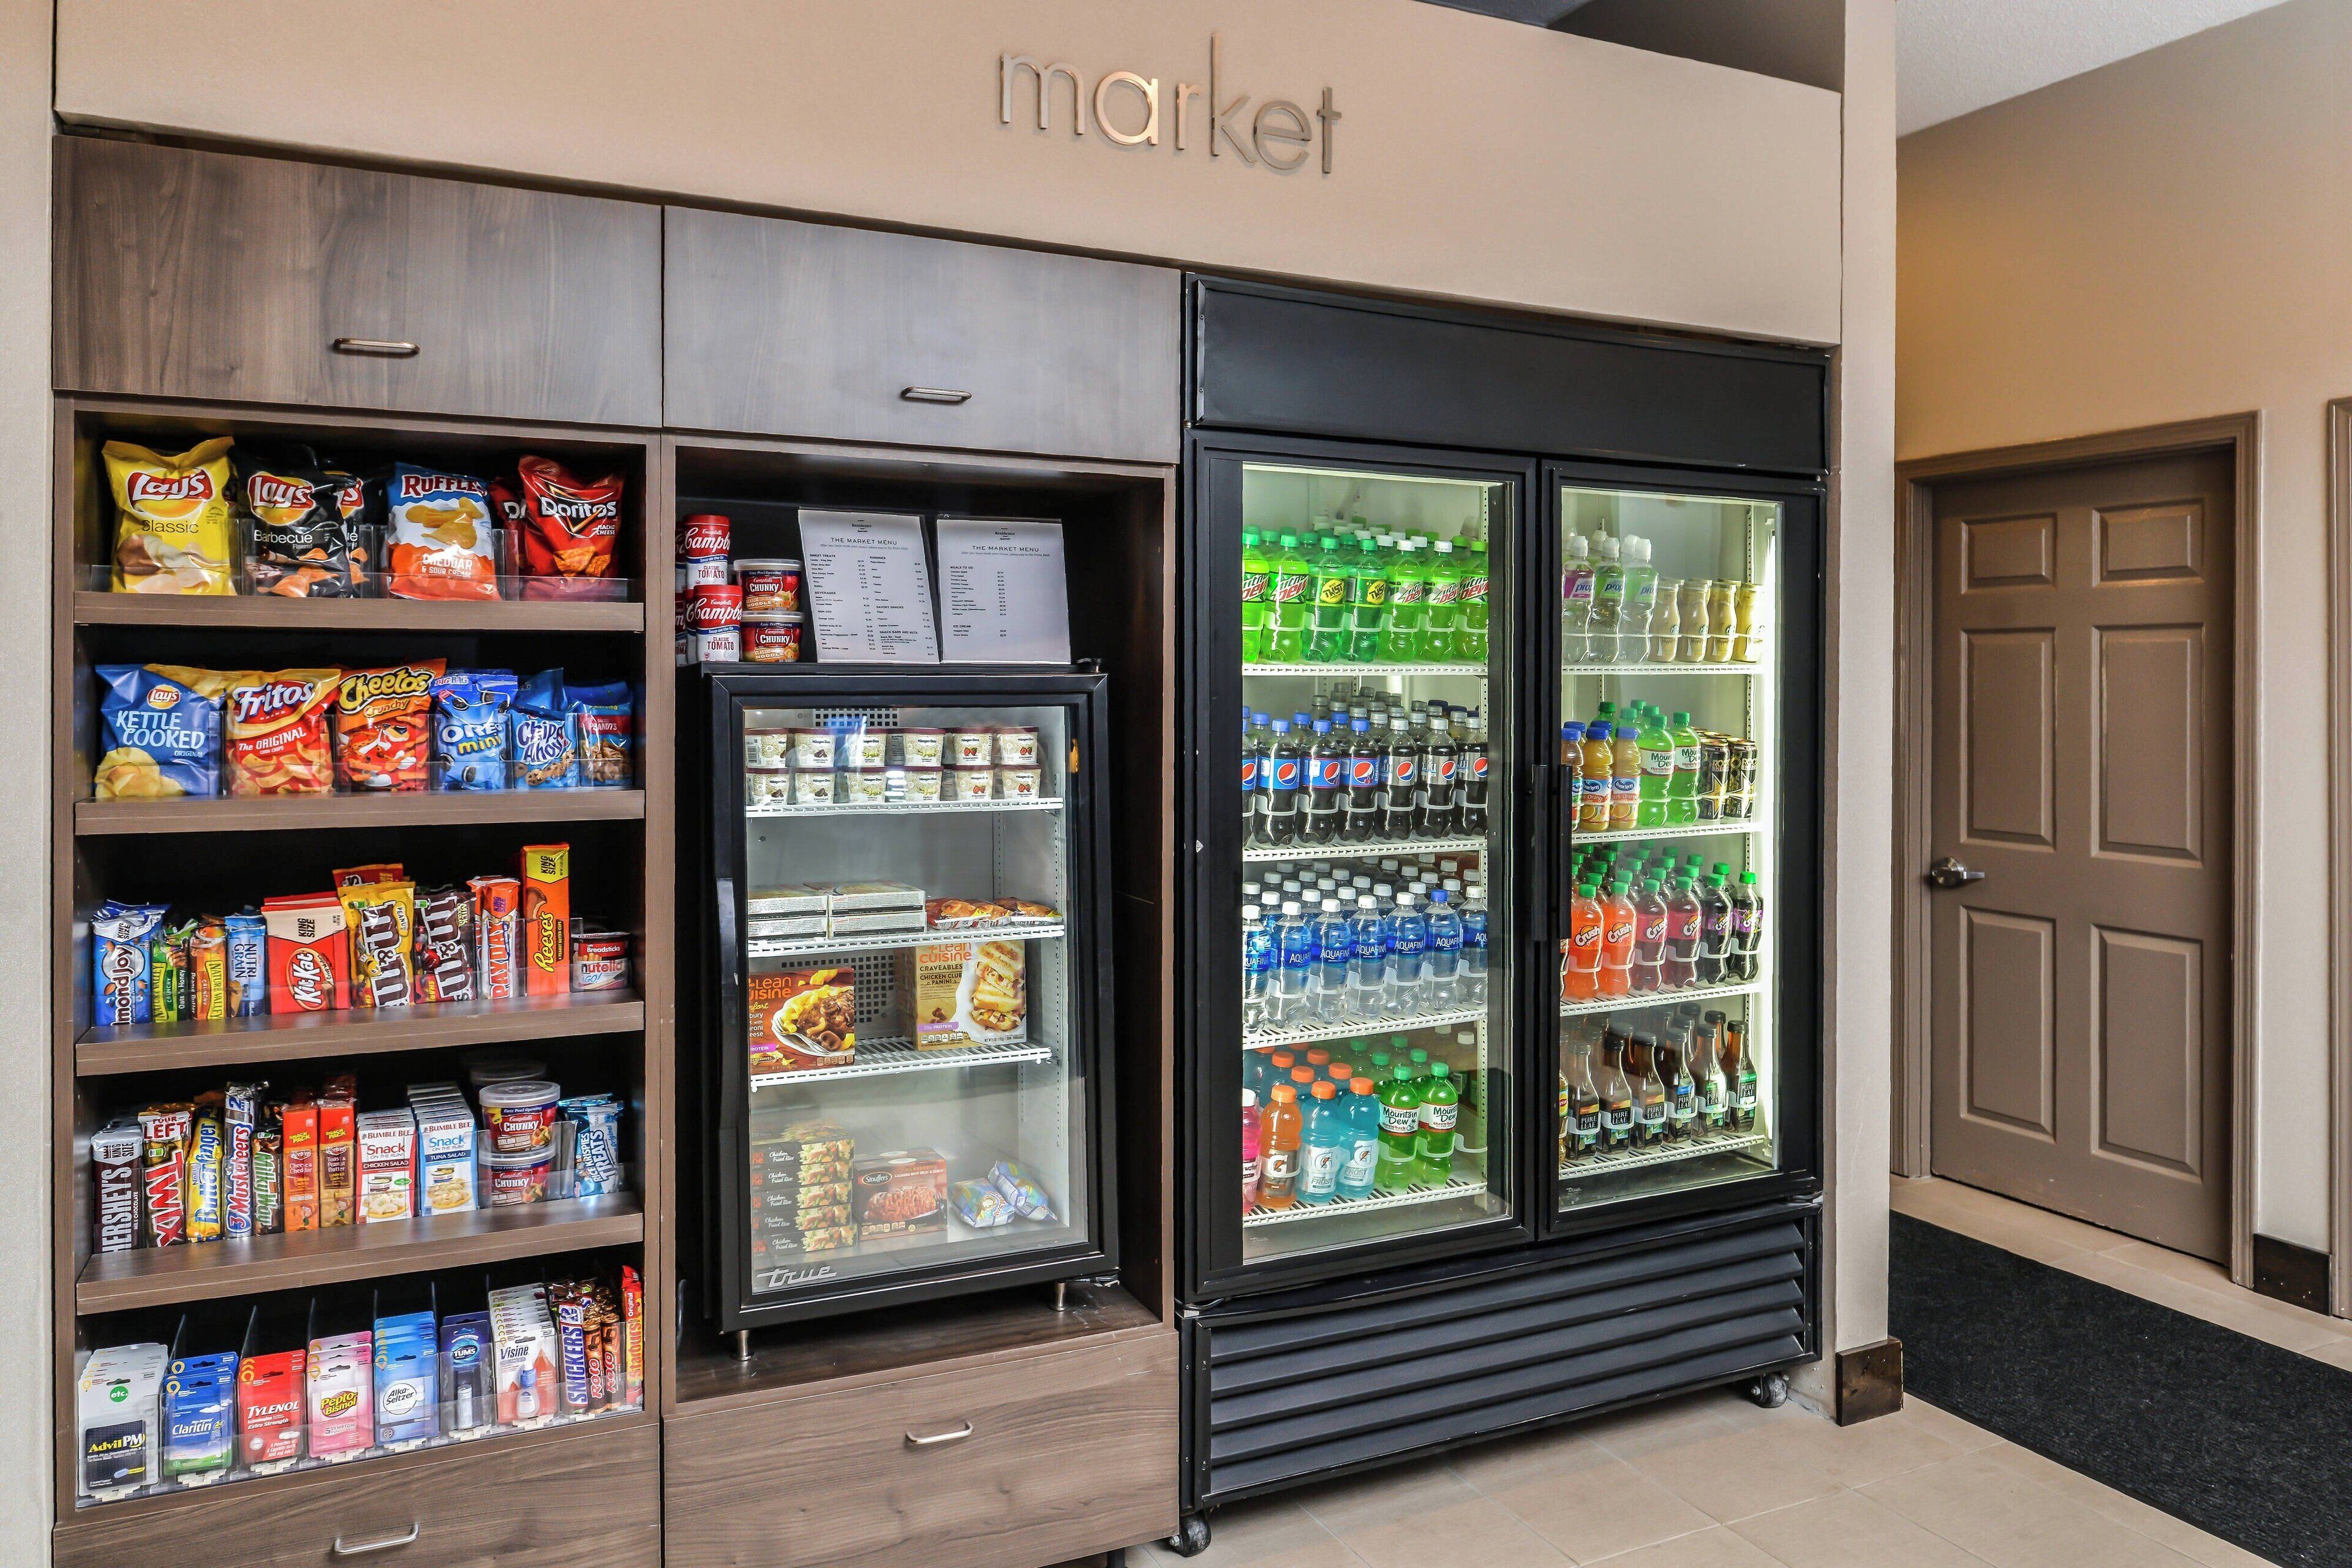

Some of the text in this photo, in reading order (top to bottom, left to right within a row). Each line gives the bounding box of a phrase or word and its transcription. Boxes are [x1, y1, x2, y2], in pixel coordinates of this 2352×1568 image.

[1000, 32, 1342, 174] market
[132, 469, 206, 501] Lay's
[254, 475, 310, 509] Lay's
[541, 497, 617, 519] Doritos
[254, 530, 314, 544] Barbecue
[698, 570, 725, 579] TOMATO
[750, 583, 779, 593] CHUNKY
[707, 641, 734, 650] TOMATO
[760, 635, 790, 644] CHUNKY
[339, 668, 432, 711] Cheetos
[451, 676, 469, 685] BAG
[149, 689, 178, 704] Lay's
[232, 682, 314, 724] Fritos
[363, 698, 409, 718] Crunchy
[116, 710, 183, 729] KETTLE
[123, 729, 205, 750] COOKED
[238, 726, 306, 752] The ORIGINAL
[518, 720, 565, 748] Chips
[458, 734, 502, 755] mini
[540, 855, 549, 875] KING
[297, 918, 306, 937] KING
[396, 906, 407, 930] PEANUT
[306, 918, 315, 938] SIZE
[1575, 925, 1601, 947] Crush
[1606, 922, 1633, 943] Crush
[533, 911, 554, 973] Reese's
[234, 943, 247, 978] GRAIN
[244, 943, 257, 978] NUTRI
[489, 920, 510, 998] PAYDAY
[581, 960, 623, 973] nutella
[111, 947, 134, 1026] lmond Joy
[756, 976, 792, 990] Lean
[229, 1096, 242, 1112] 2
[1383, 1106, 1418, 1120] Mountain
[1385, 1116, 1409, 1125] Dew
[1613, 1110, 1628, 1119] PURE
[144, 1121, 187, 1140] LEFT
[503, 1120, 539, 1132] CHUNKY
[292, 1134, 311, 1144] PACK
[429, 1135, 466, 1148] Snack
[111, 1143, 121, 1159] KING
[122, 1142, 134, 1157] SIZE
[366, 1143, 405, 1155] Snack
[590, 1129, 616, 1180] TREATS
[1268, 1155, 1288, 1175] G
[1314, 1152, 1333, 1170] G
[195, 1123, 222, 1224] Butterfinger
[228, 1127, 250, 1230] 3 Musketeers
[254, 1152, 277, 1196] Milky
[1344, 1168, 1368, 1177] FROST
[495, 1178, 530, 1188] CHUNKY
[145, 1149, 184, 1247] TWIX
[101, 1166, 132, 1253] HERSHEY'S
[453, 1348, 476, 1357] TUMS
[500, 1345, 529, 1360] Visine
[563, 1325, 587, 1404] SNICKERS
[589, 1358, 602, 1399] ROLO
[110, 1390, 129, 1399] etc.
[320, 1392, 358, 1410] Pepto-
[386, 1392, 414, 1406] Seltzer
[388, 1387, 409, 1397] Alka-
[247, 1401, 300, 1419] TYLENOL
[325, 1396, 357, 1416] Bismol
[172, 1422, 213, 1436] Claritin
[263, 1418, 289, 1427] Strength
[88, 1433, 143, 1453] Advil PM
